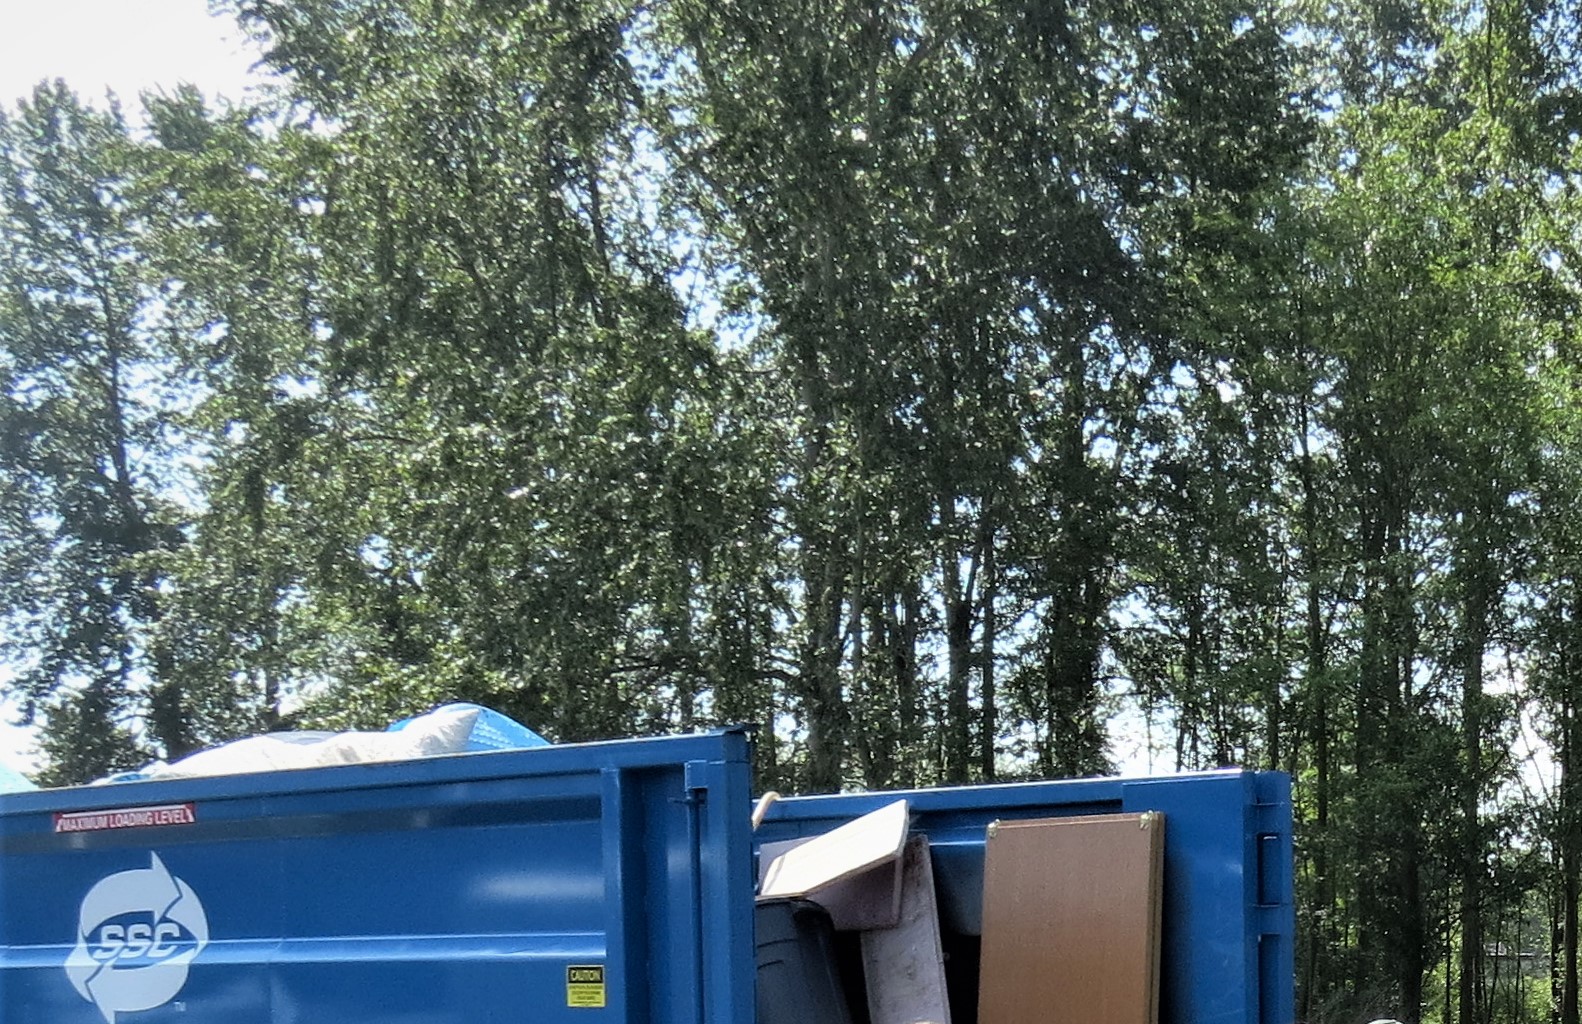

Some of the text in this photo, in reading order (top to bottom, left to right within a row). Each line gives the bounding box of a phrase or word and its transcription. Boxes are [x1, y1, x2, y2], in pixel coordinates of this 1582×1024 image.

[109, 811, 151, 828] LOADING
[155, 808, 186, 824] LEVEL
[93, 923, 180, 959] SSC
